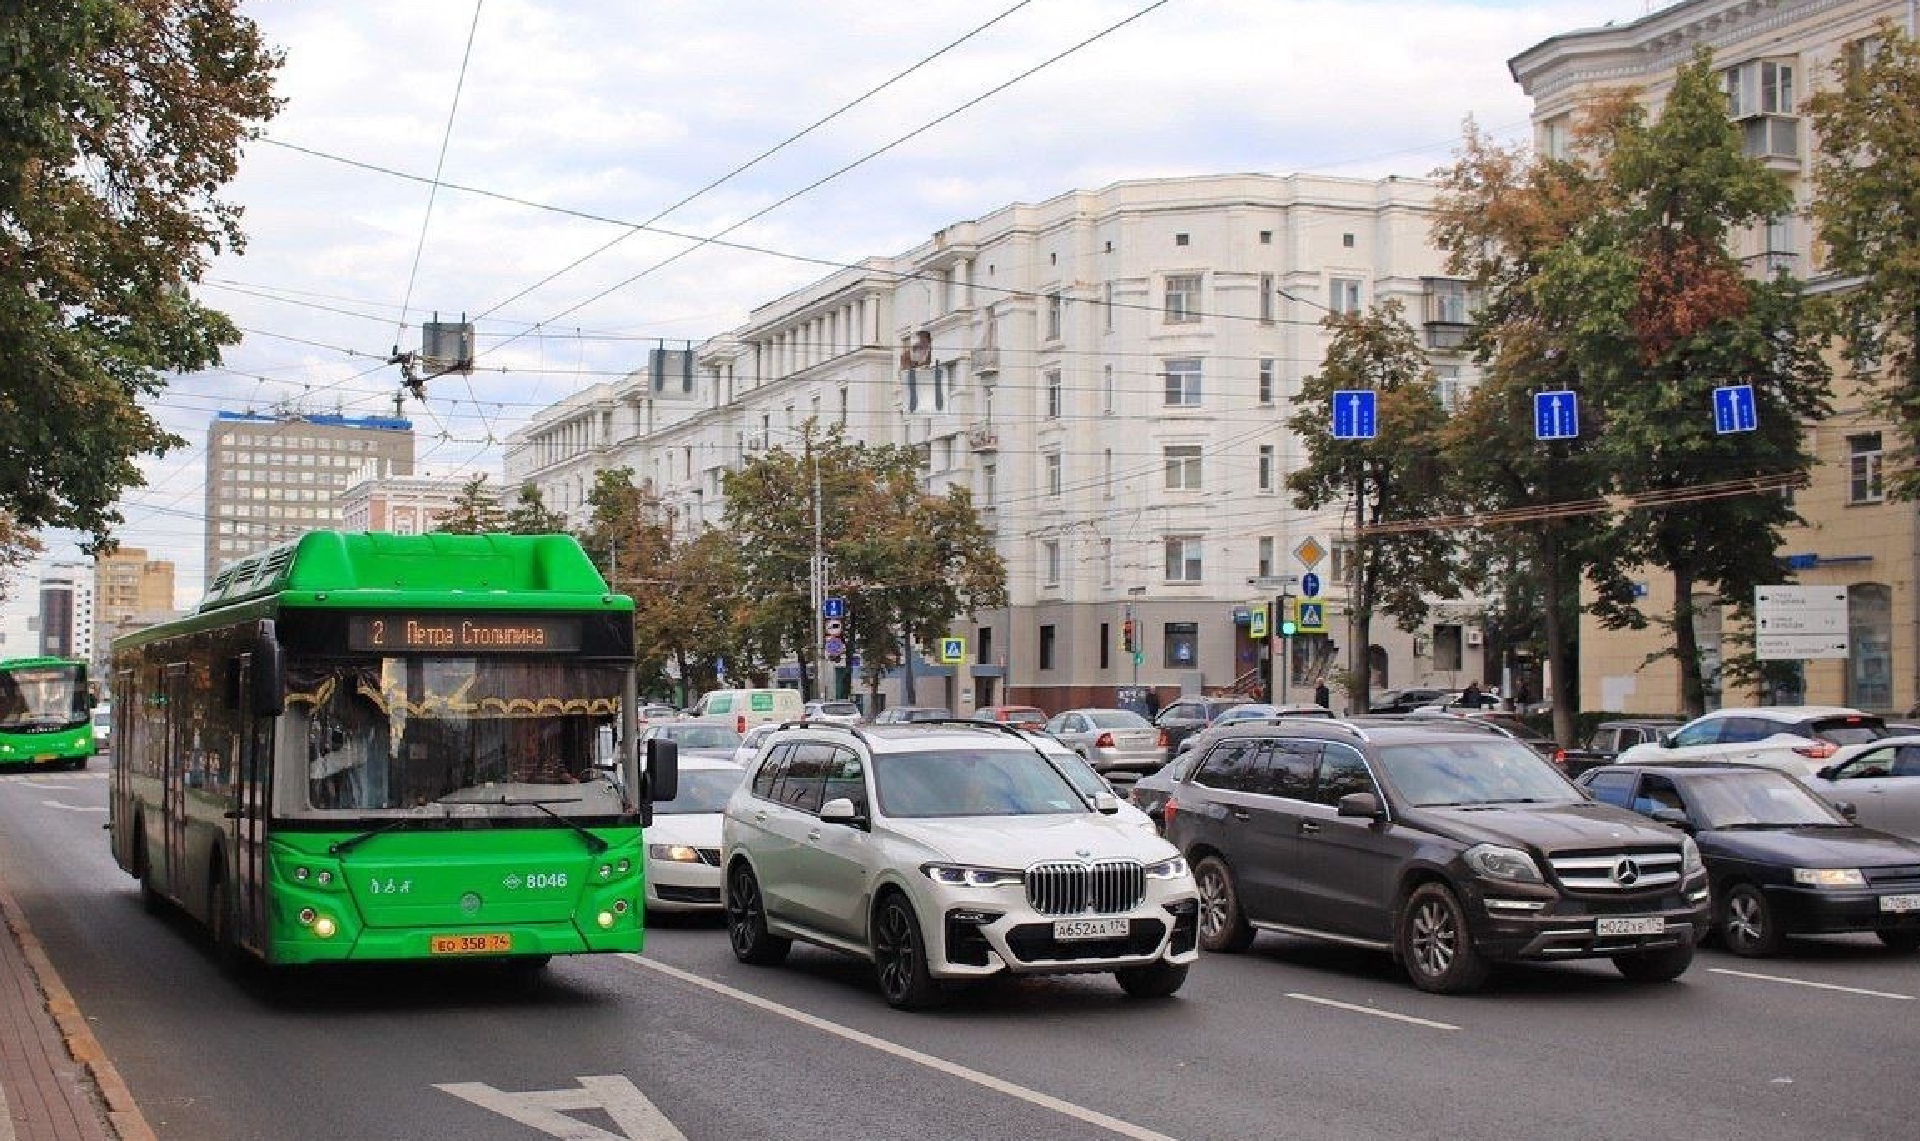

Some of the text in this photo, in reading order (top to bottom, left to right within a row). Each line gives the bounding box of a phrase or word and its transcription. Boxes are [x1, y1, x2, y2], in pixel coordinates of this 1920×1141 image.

[373, 620, 544, 646] 2 Петра Столыпина
[527, 873, 568, 889] 8046
